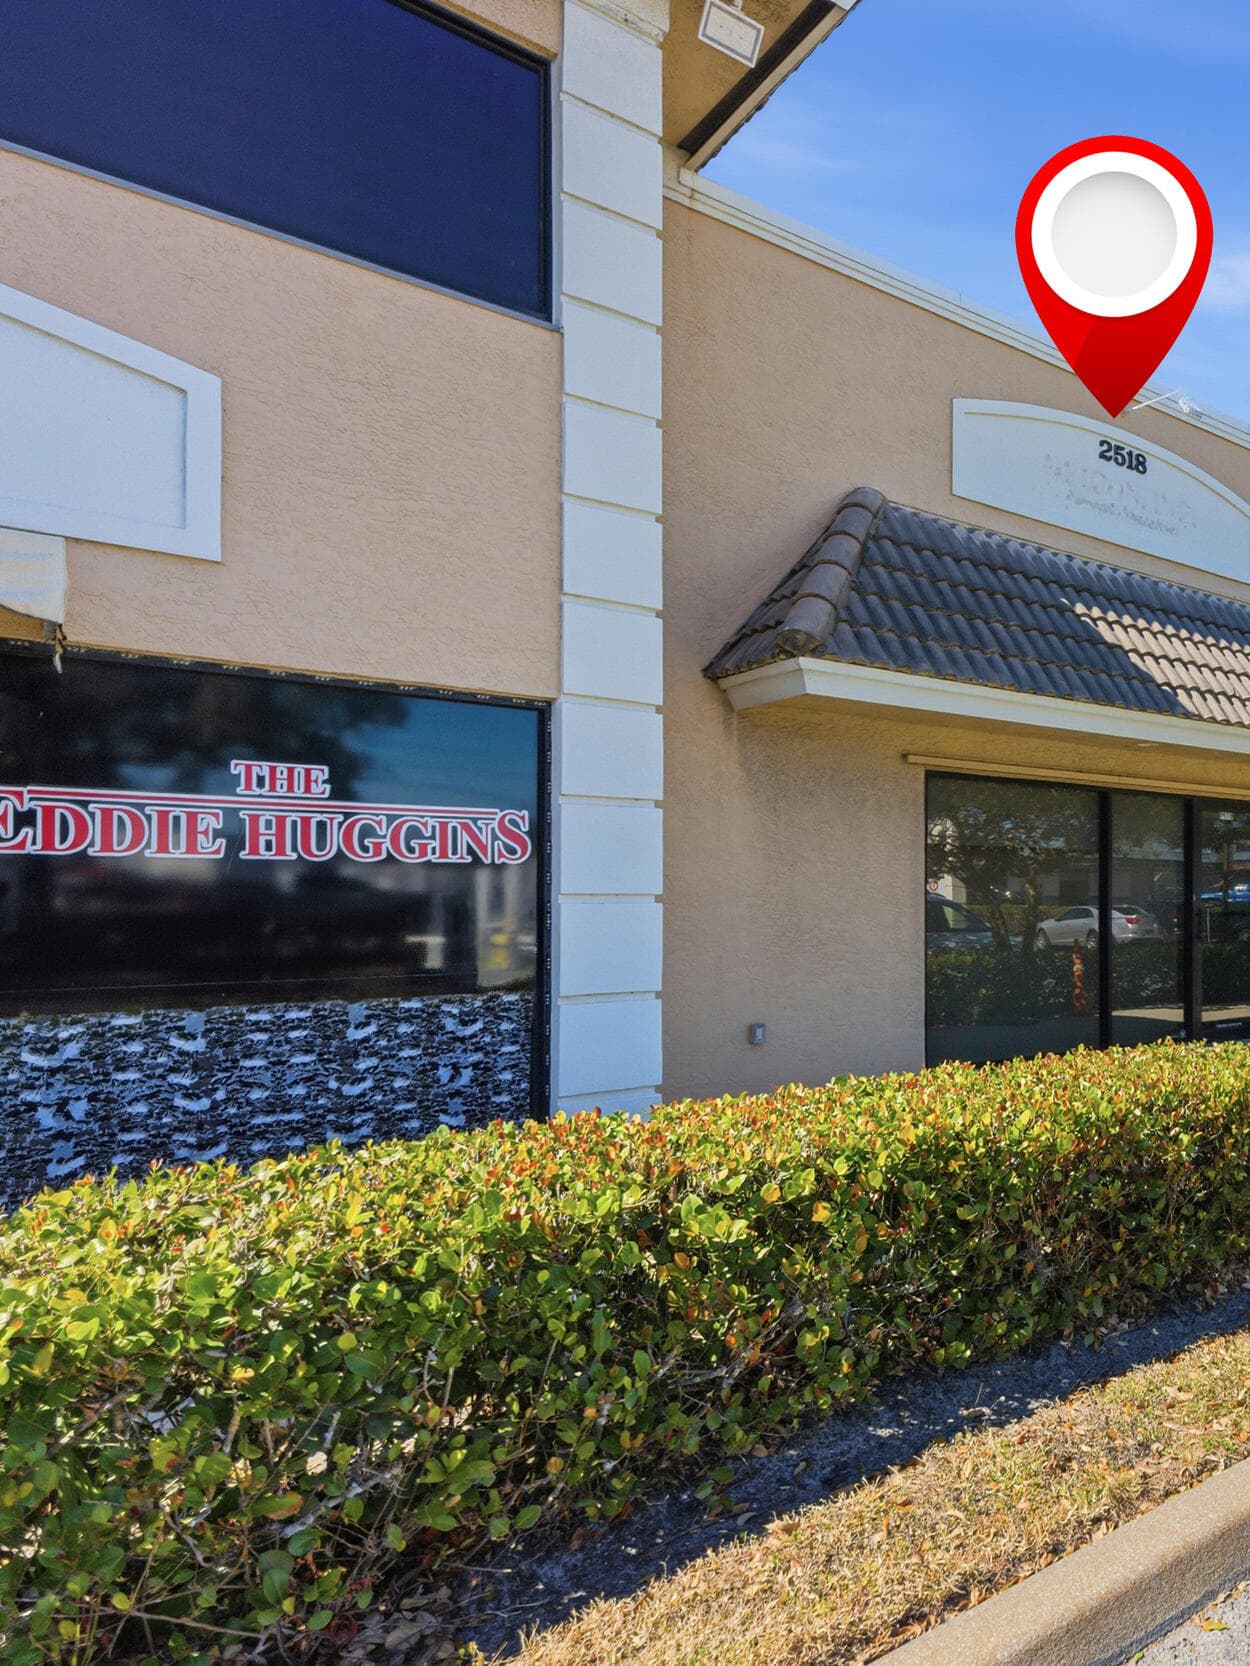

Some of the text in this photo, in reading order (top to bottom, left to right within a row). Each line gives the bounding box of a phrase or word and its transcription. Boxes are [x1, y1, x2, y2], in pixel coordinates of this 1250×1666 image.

[1098, 439, 1147, 475] 2518
[230, 759, 330, 797] THE
[240, 810, 532, 864] HUGGINS
